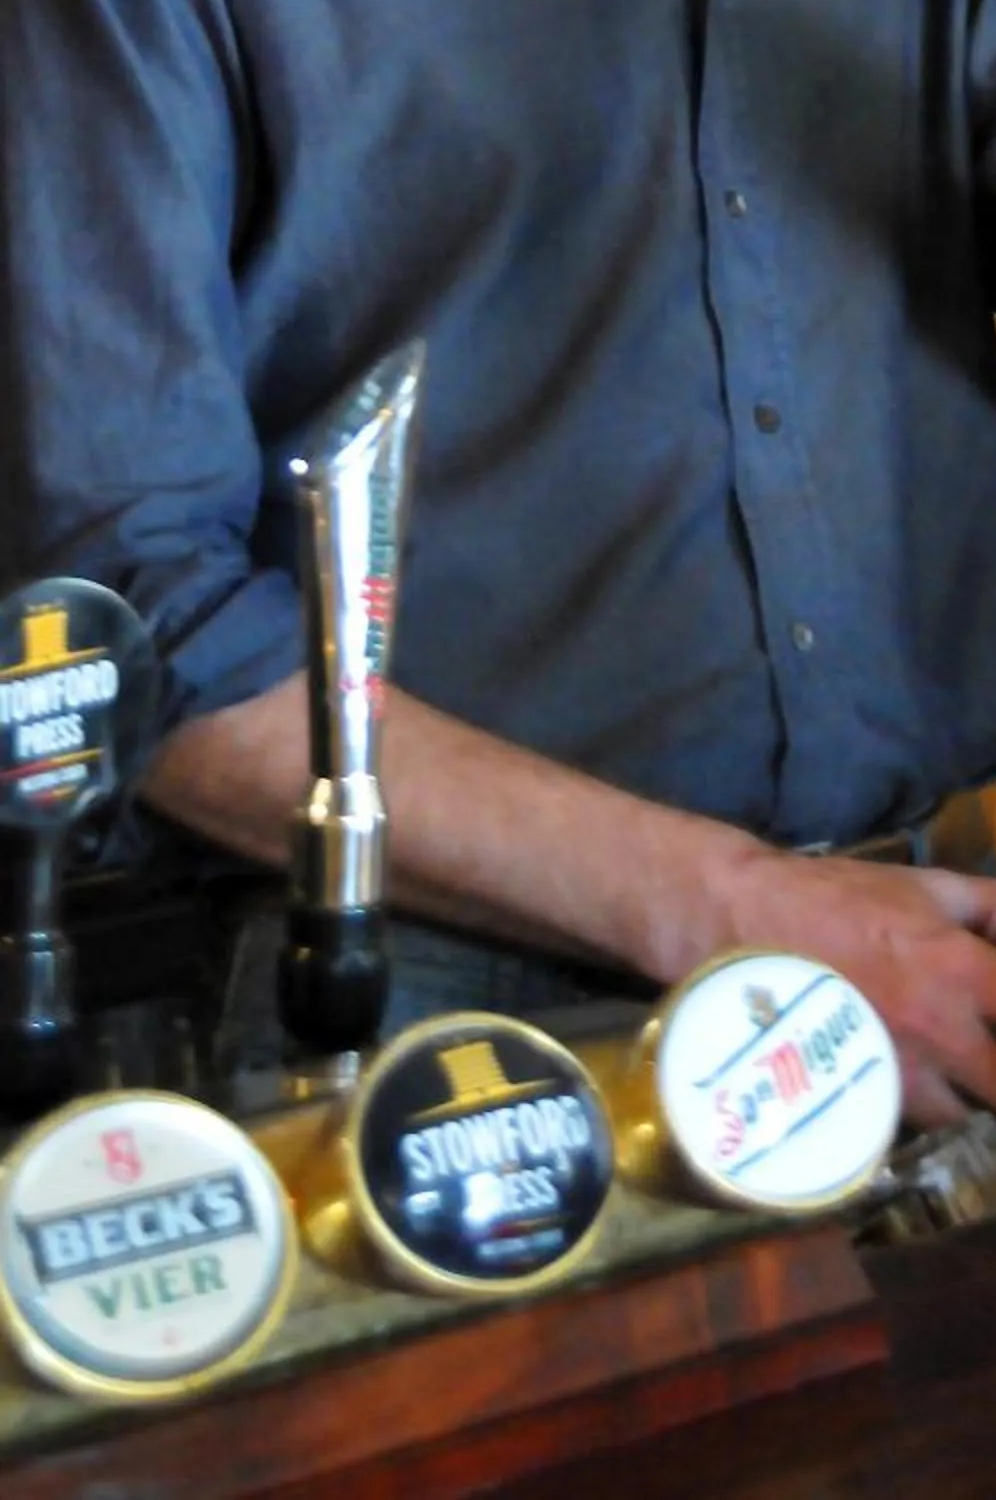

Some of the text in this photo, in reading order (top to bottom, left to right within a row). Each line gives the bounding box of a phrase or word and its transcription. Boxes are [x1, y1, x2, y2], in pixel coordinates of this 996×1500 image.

[0, 658, 120, 725] TOWFORD
[401, 1094, 591, 1182] STOWFORD
[85, 1251, 228, 1320] VIER
